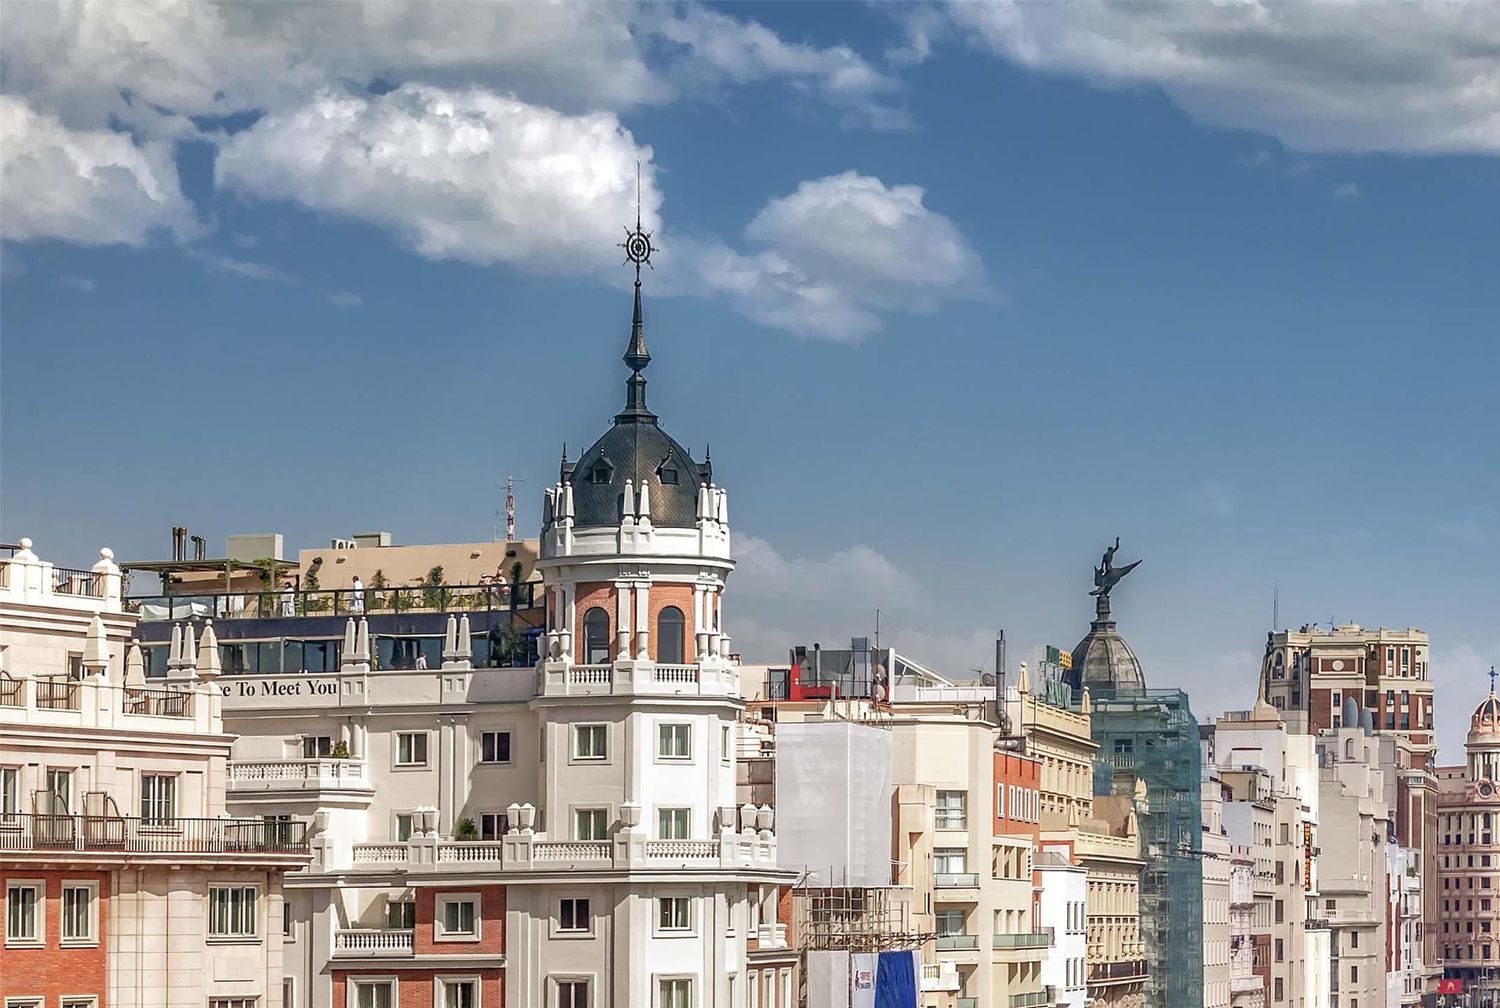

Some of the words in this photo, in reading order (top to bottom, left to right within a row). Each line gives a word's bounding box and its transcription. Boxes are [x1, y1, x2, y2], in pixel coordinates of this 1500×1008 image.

[235, 681, 256, 697] To
[261, 680, 301, 697] Meet
[307, 679, 338, 695] You
